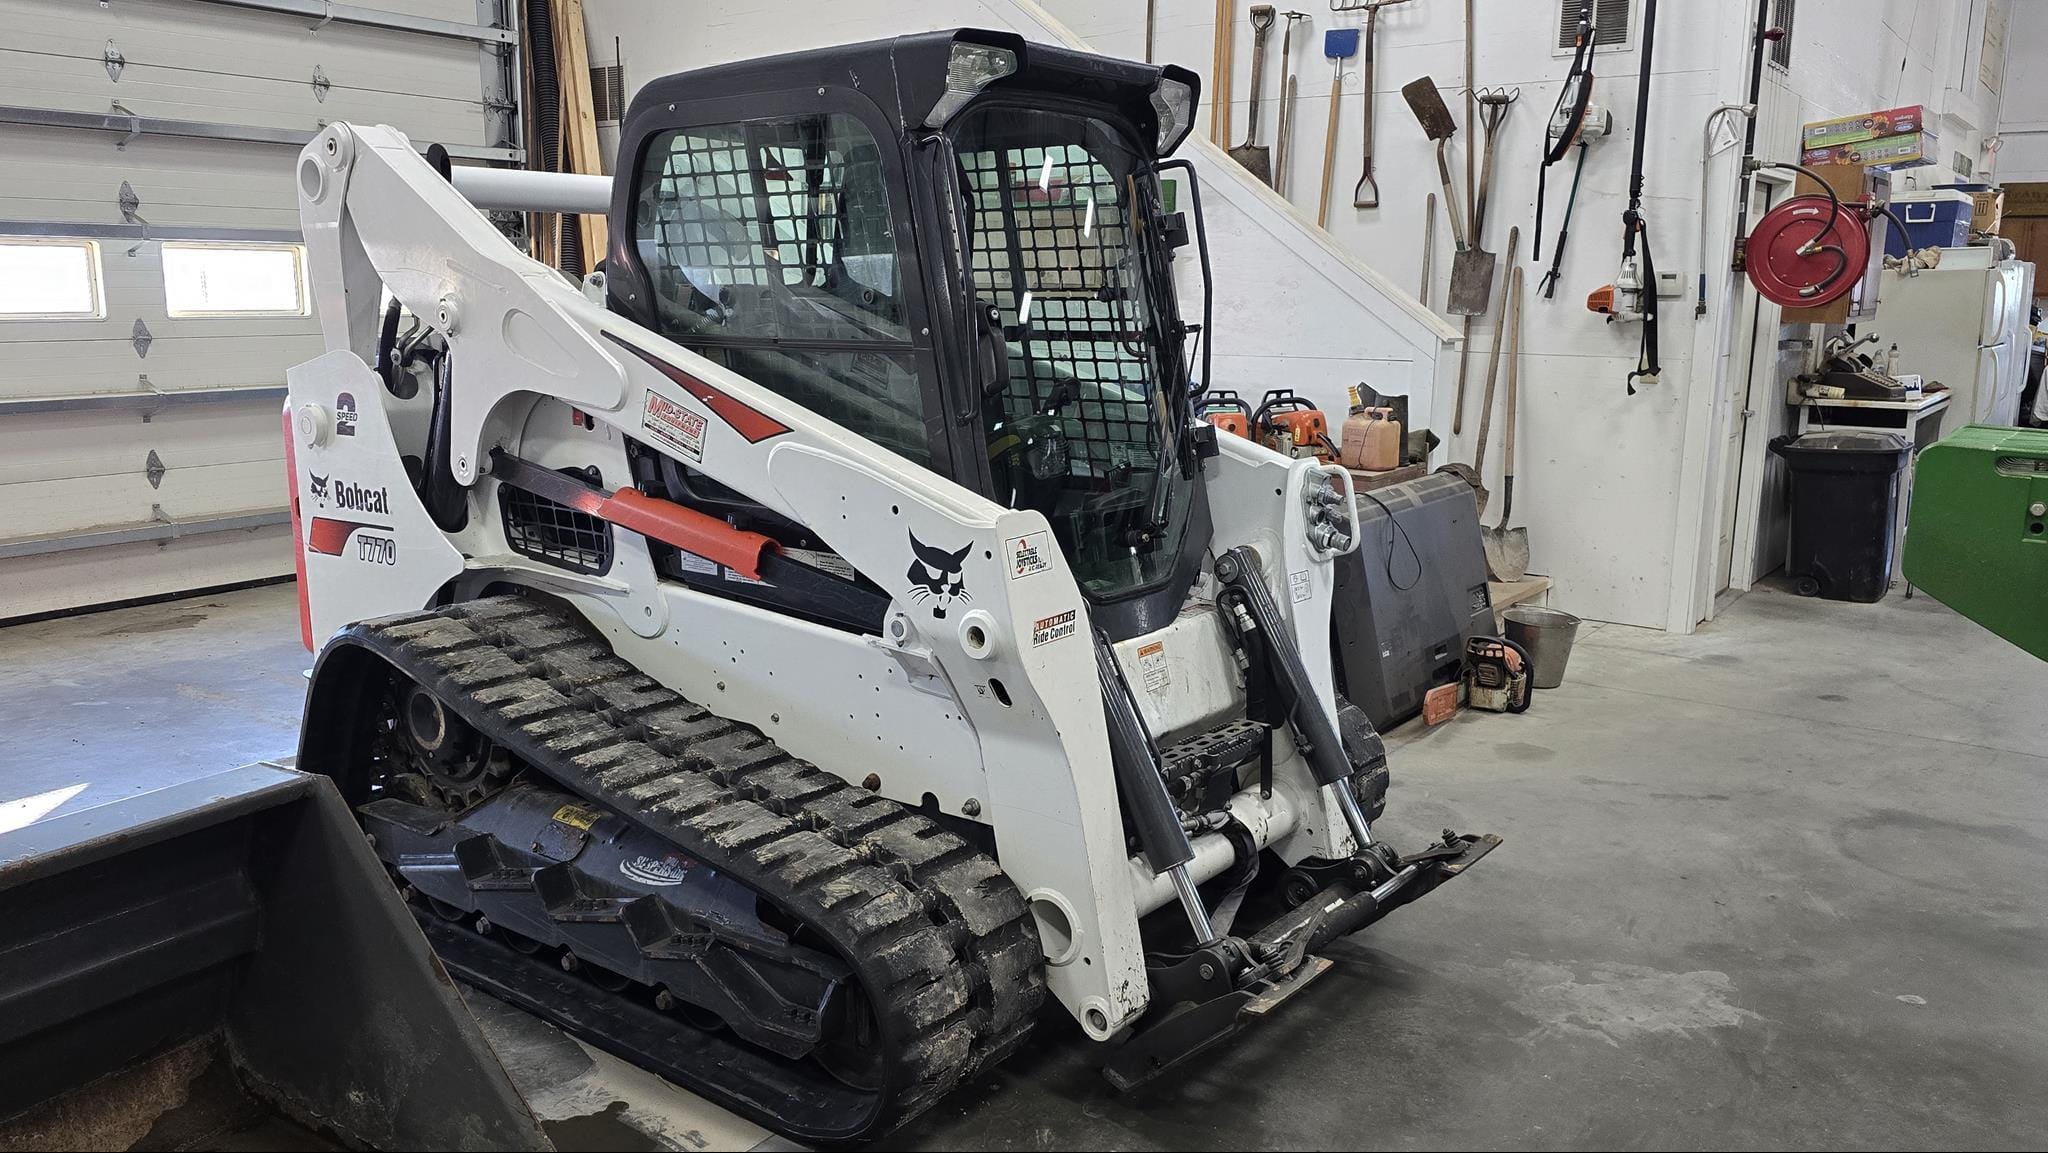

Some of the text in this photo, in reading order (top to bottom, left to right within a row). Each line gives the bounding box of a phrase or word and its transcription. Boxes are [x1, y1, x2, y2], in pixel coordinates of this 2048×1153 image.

[336, 392, 356, 436] 2
[336, 411, 358, 422] SPEED
[647, 396, 704, 431] MID-STATE
[334, 480, 390, 515] Bobcat
[357, 534, 397, 566] T770
[1033, 621, 1076, 645] Ride Control
[1035, 611, 1075, 631] AUTOMATIC
